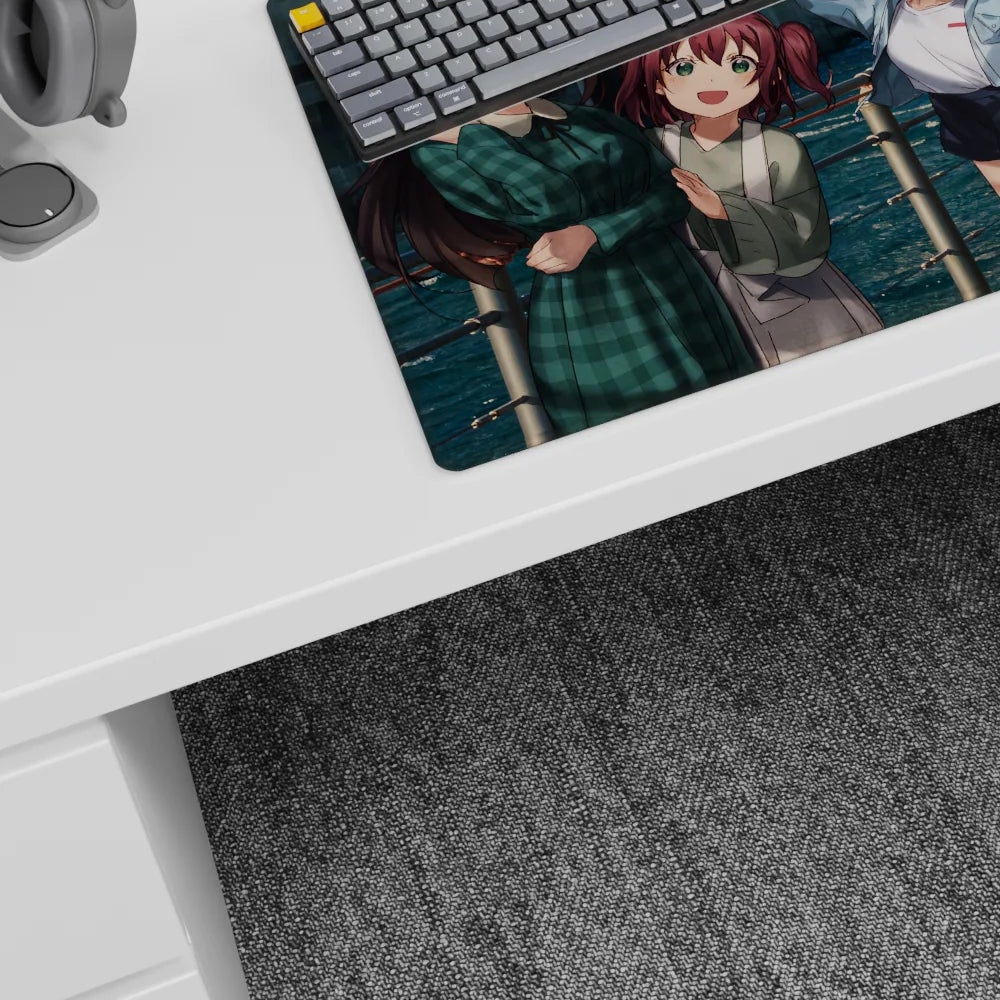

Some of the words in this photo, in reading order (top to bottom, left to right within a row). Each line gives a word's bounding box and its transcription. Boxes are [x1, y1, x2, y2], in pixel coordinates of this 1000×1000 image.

[368, 89, 382, 98] shift
[438, 85, 466, 98] command
[403, 102, 423, 113] option
[362, 116, 383, 128] control
